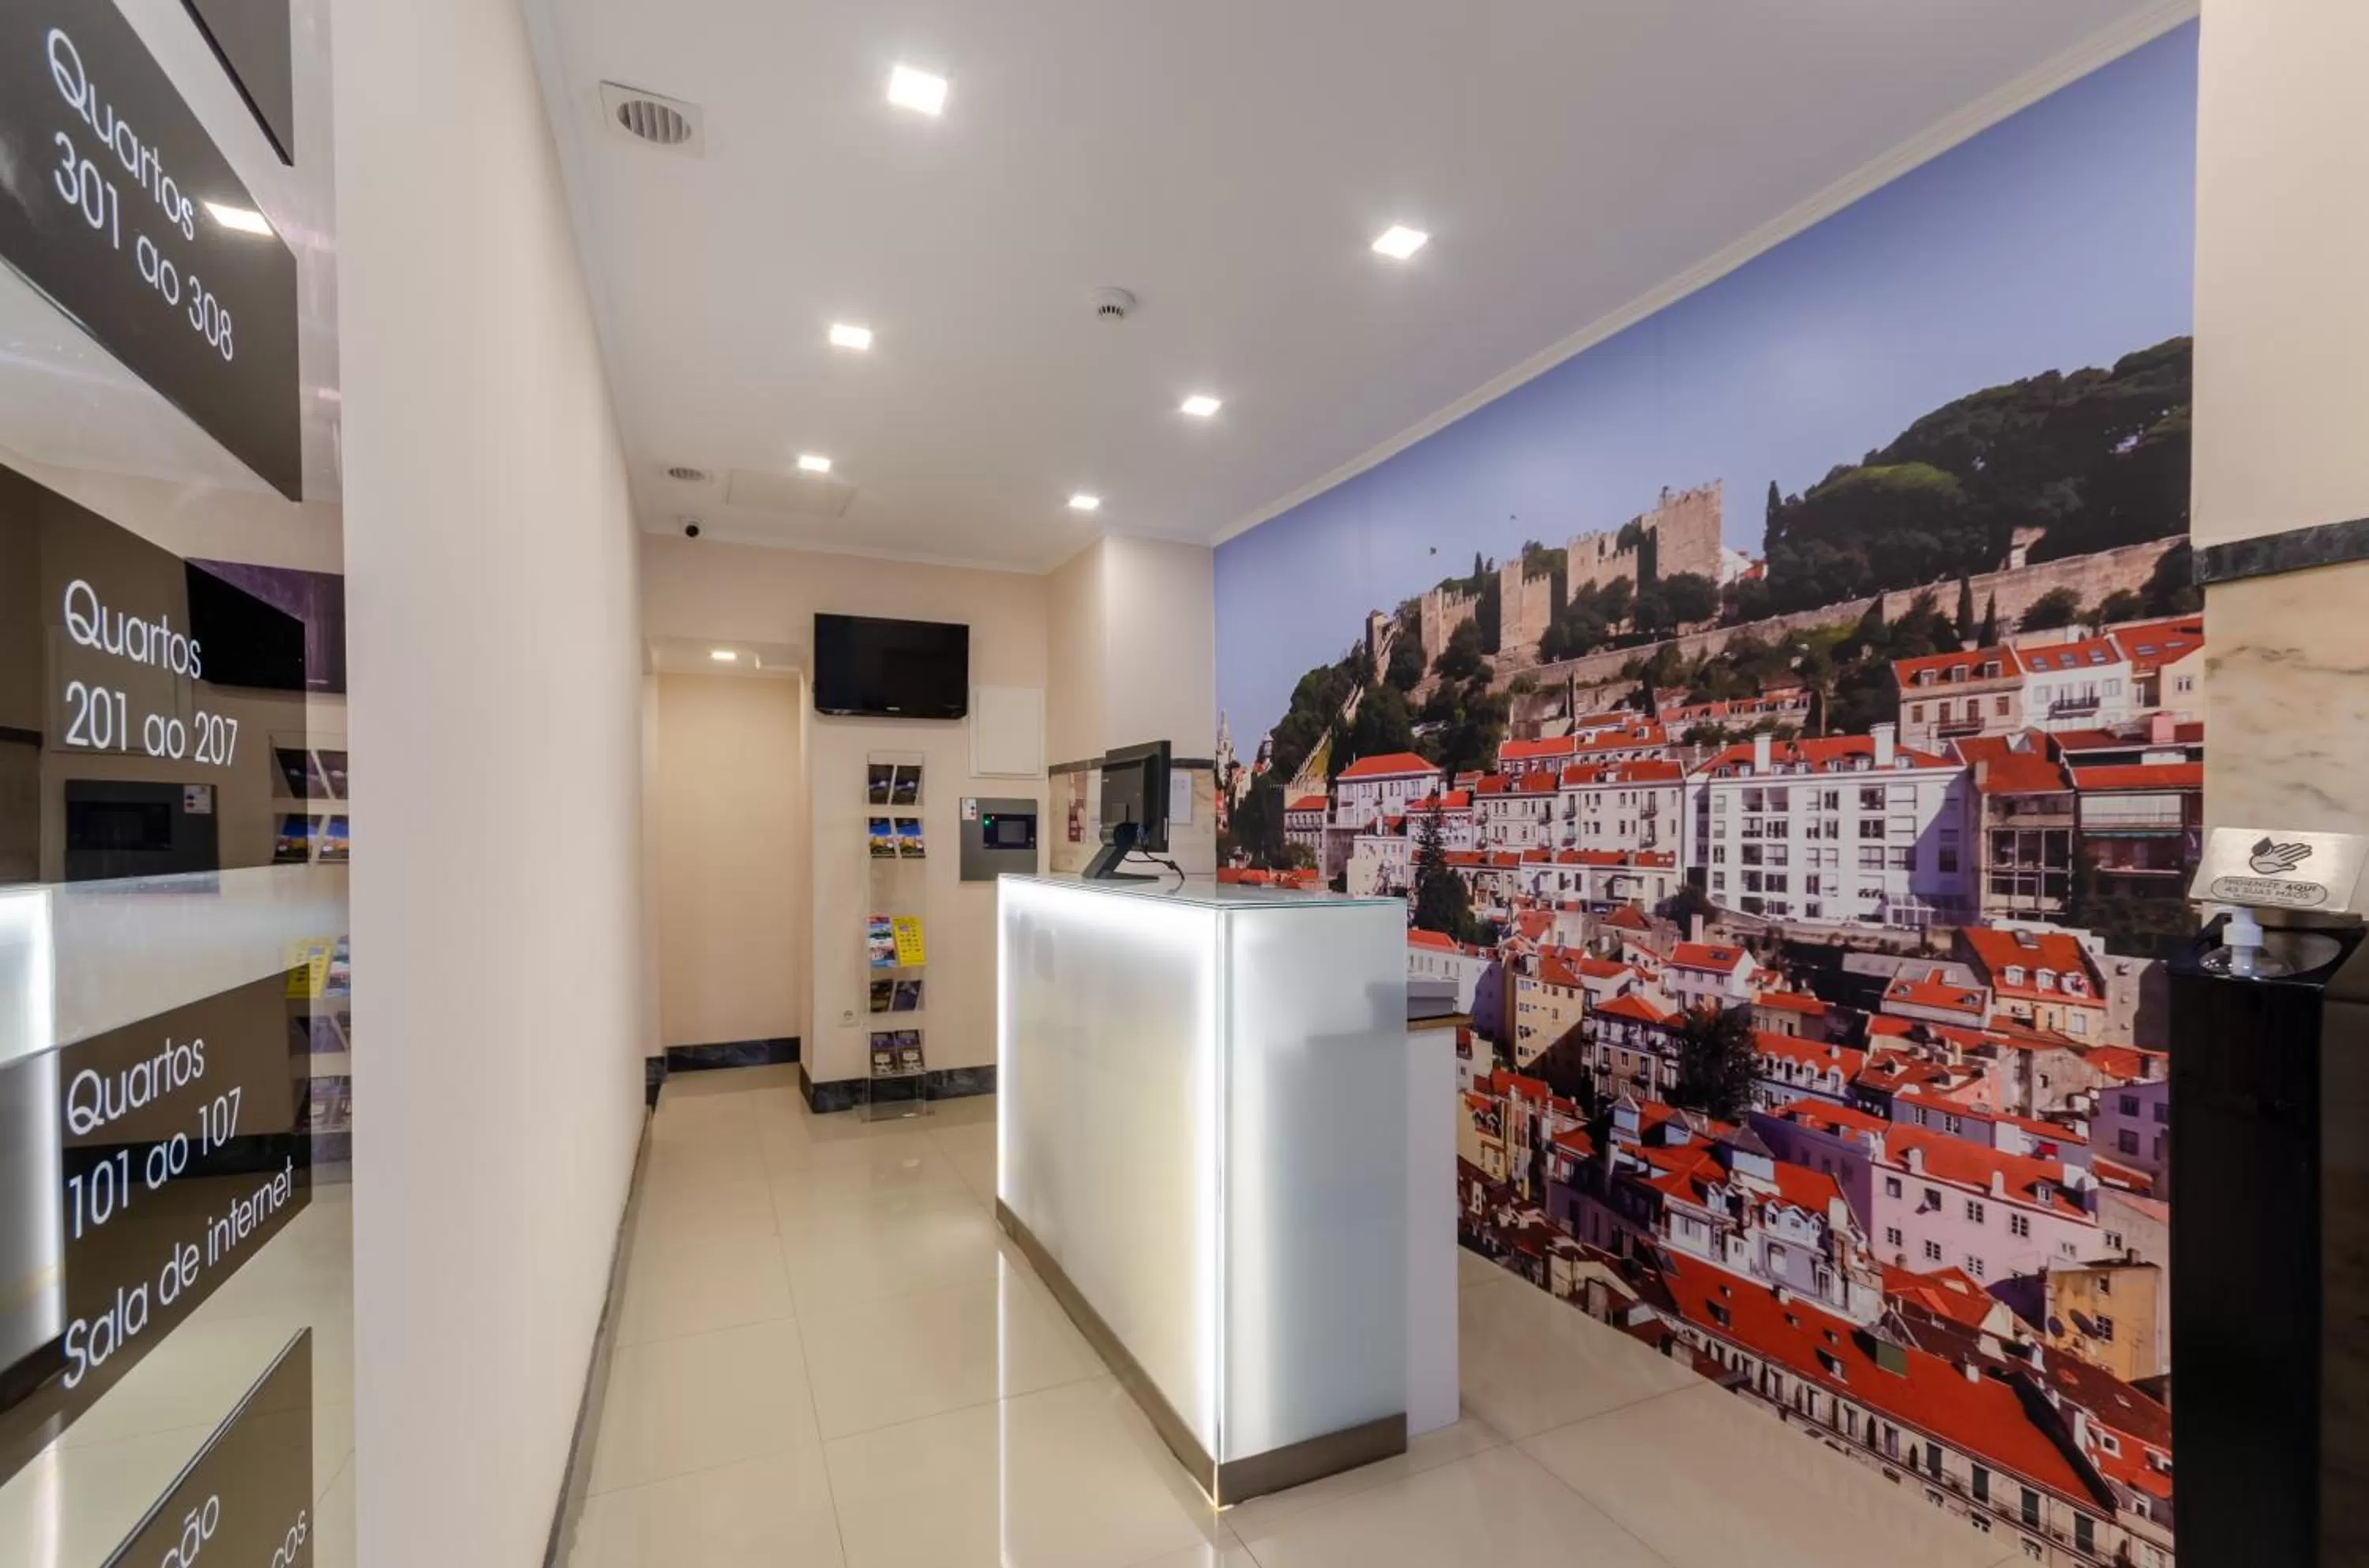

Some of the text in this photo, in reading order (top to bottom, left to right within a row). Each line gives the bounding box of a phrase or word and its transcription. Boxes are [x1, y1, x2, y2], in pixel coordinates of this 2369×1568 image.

[48, 28, 194, 241] Quartos
[54, 132, 233, 361] 301 ao 308
[64, 580, 202, 679] Quartos
[65, 681, 238, 767] 201 ao 207
[66, 1037, 205, 1136] Quartos
[69, 1086, 242, 1239] 101 ao 107
[62, 1155, 295, 1390] Sala de internet
